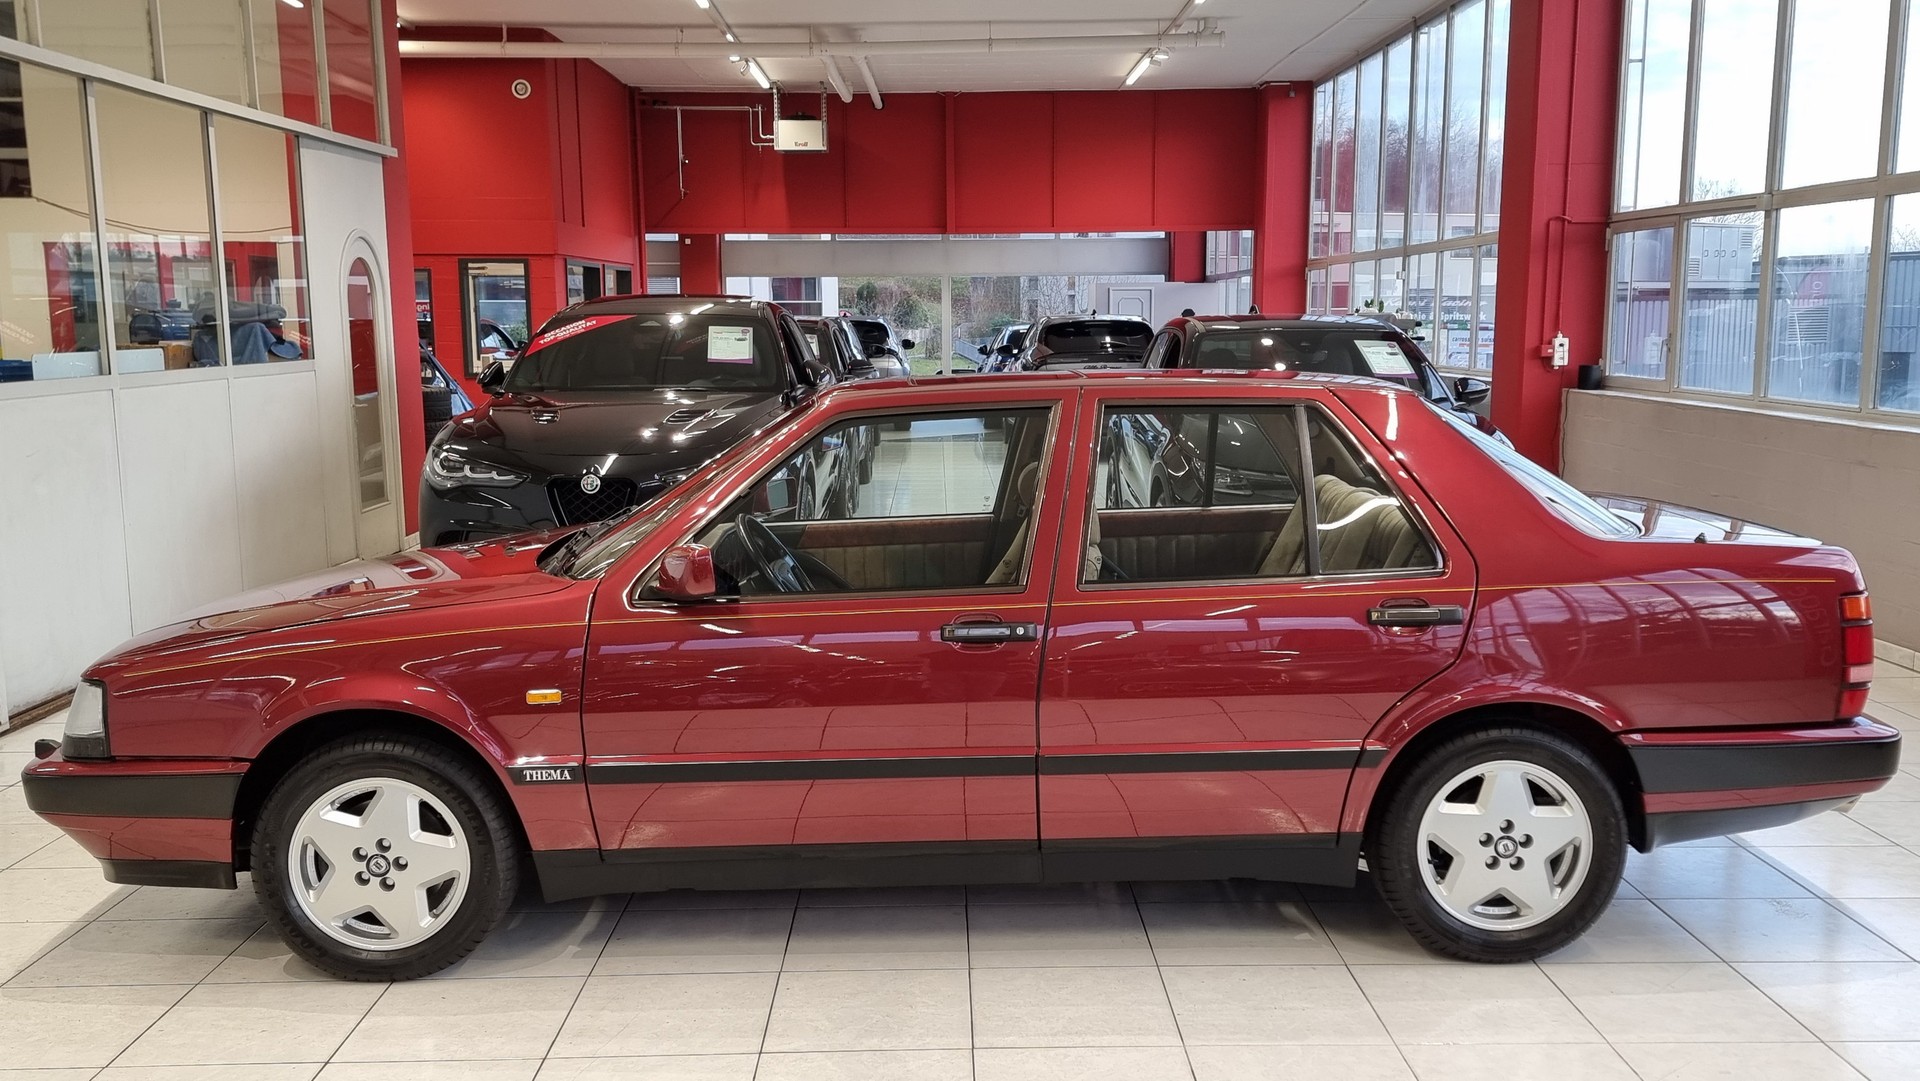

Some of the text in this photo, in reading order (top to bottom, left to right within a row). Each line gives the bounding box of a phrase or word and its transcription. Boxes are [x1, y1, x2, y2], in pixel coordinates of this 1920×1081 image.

[1441, 311, 1487, 322] Spritzwk
[544, 320, 586, 338] OCCASION
[523, 769, 571, 781] THEMA
